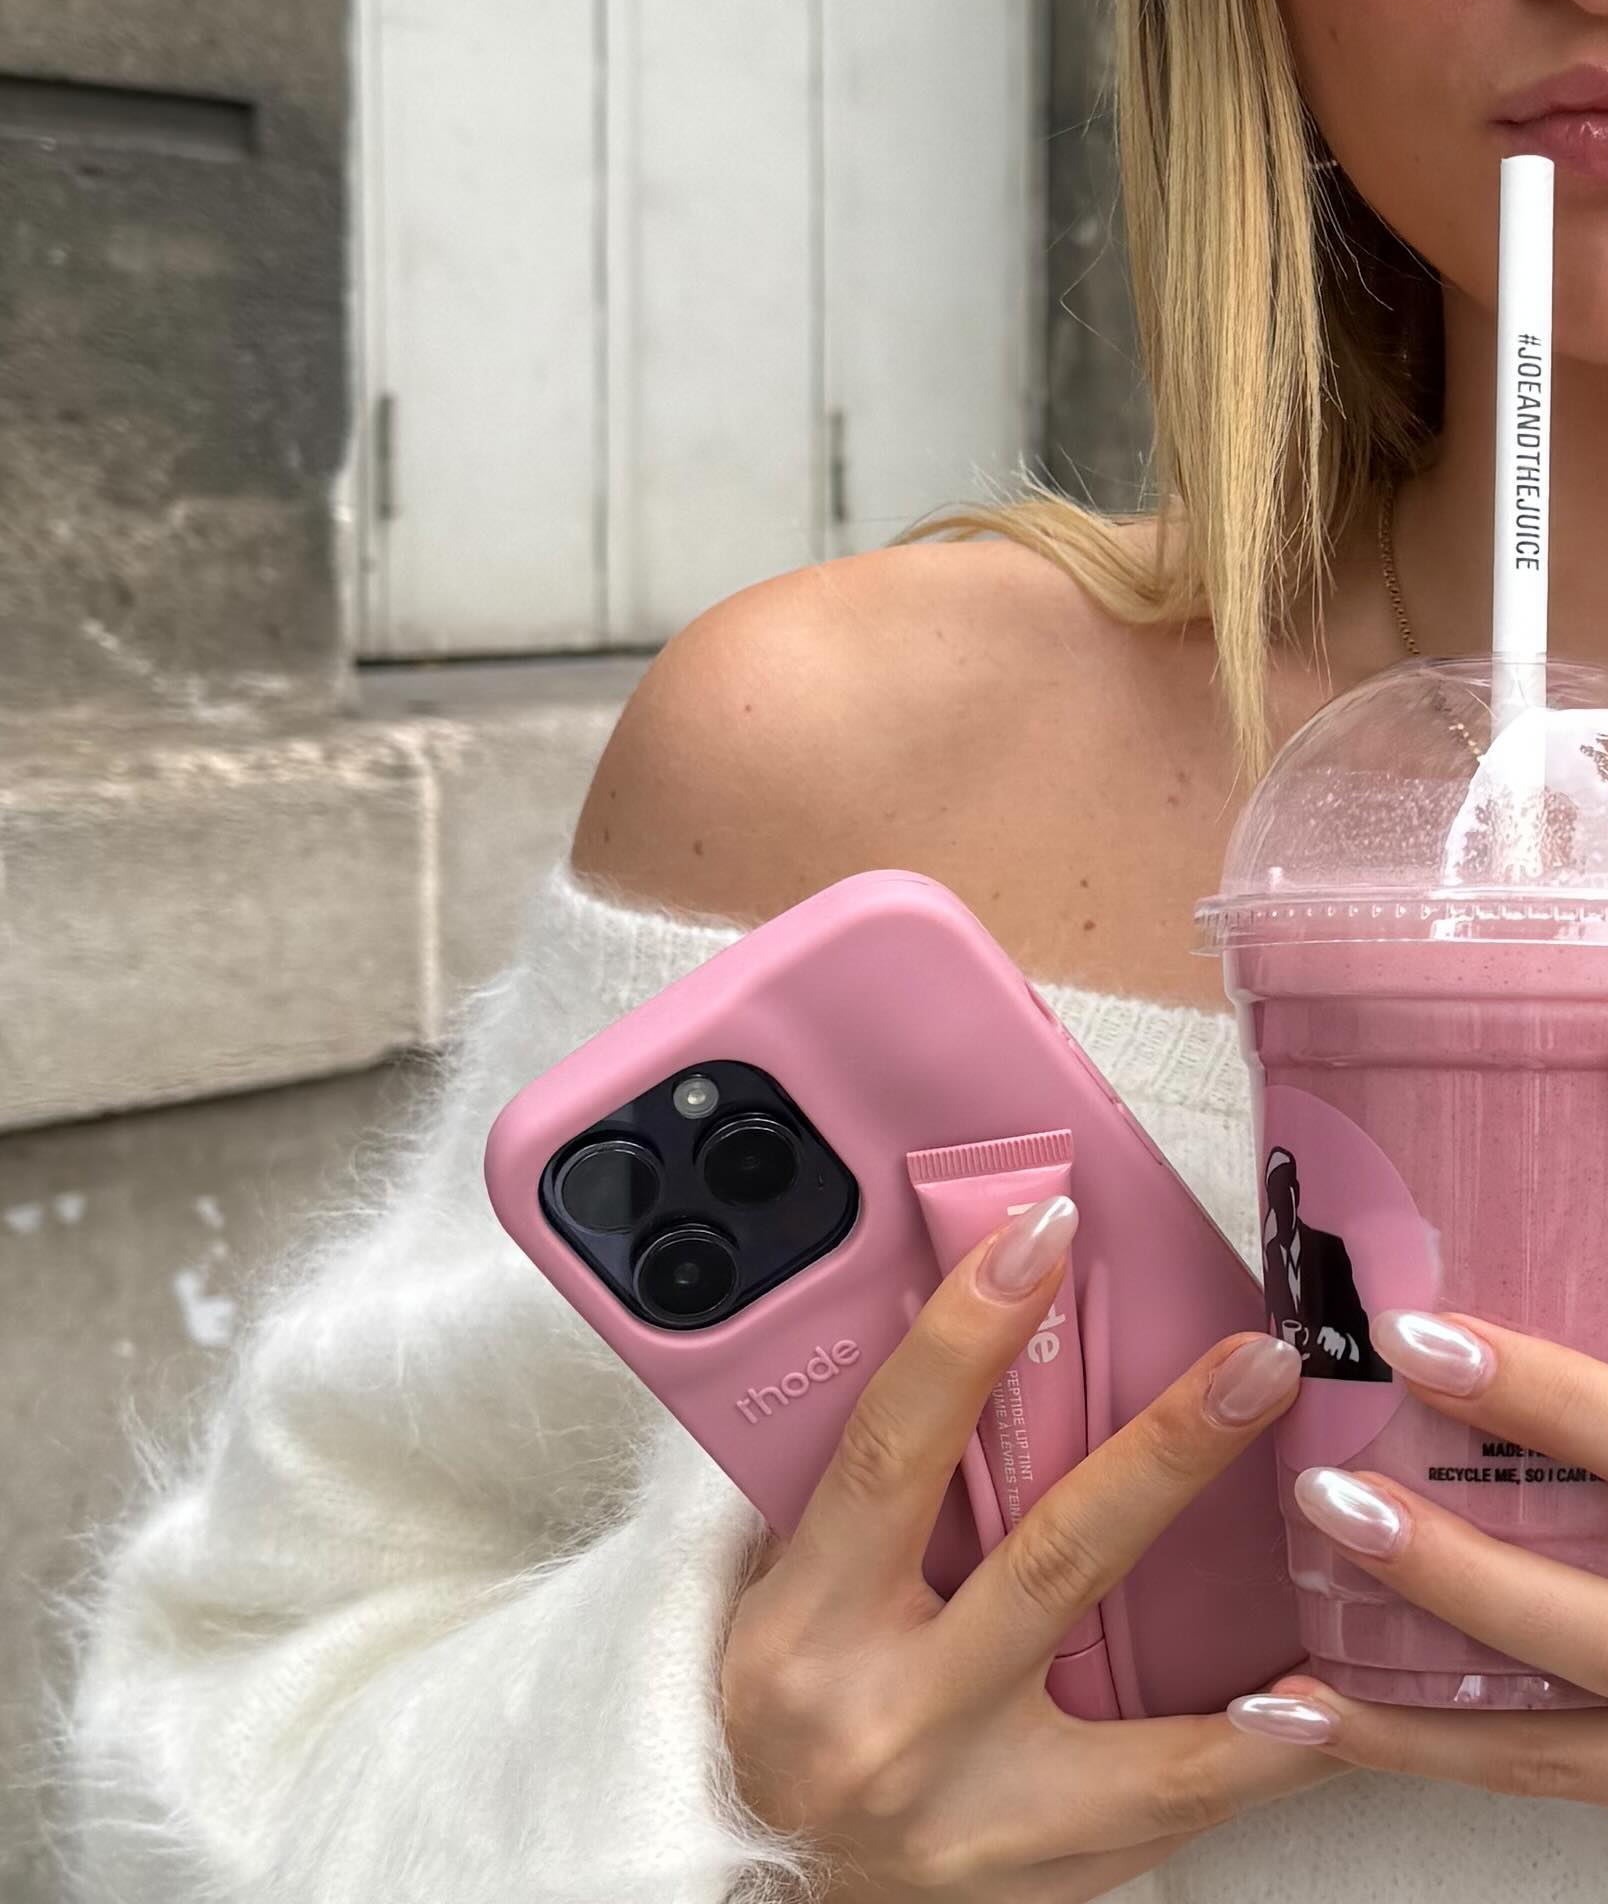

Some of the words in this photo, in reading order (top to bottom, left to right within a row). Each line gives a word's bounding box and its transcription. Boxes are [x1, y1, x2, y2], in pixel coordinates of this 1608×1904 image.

[1515, 333, 1542, 571] #JOEANDTHEJUICE
[736, 1339, 861, 1424] rhode
[1005, 1369, 1025, 1426] PEPTIDE
[1015, 1429, 1029, 1449] LIP
[1482, 1443, 1525, 1457] MADE
[1019, 1452, 1033, 1481] TINT
[1428, 1467, 1492, 1482] RECYCLE
[1494, 1468, 1520, 1485] ME,
[1525, 1468, 1544, 1482] SO
[1548, 1468, 1554, 1482] I
[1556, 1468, 1586, 1482] CAN
